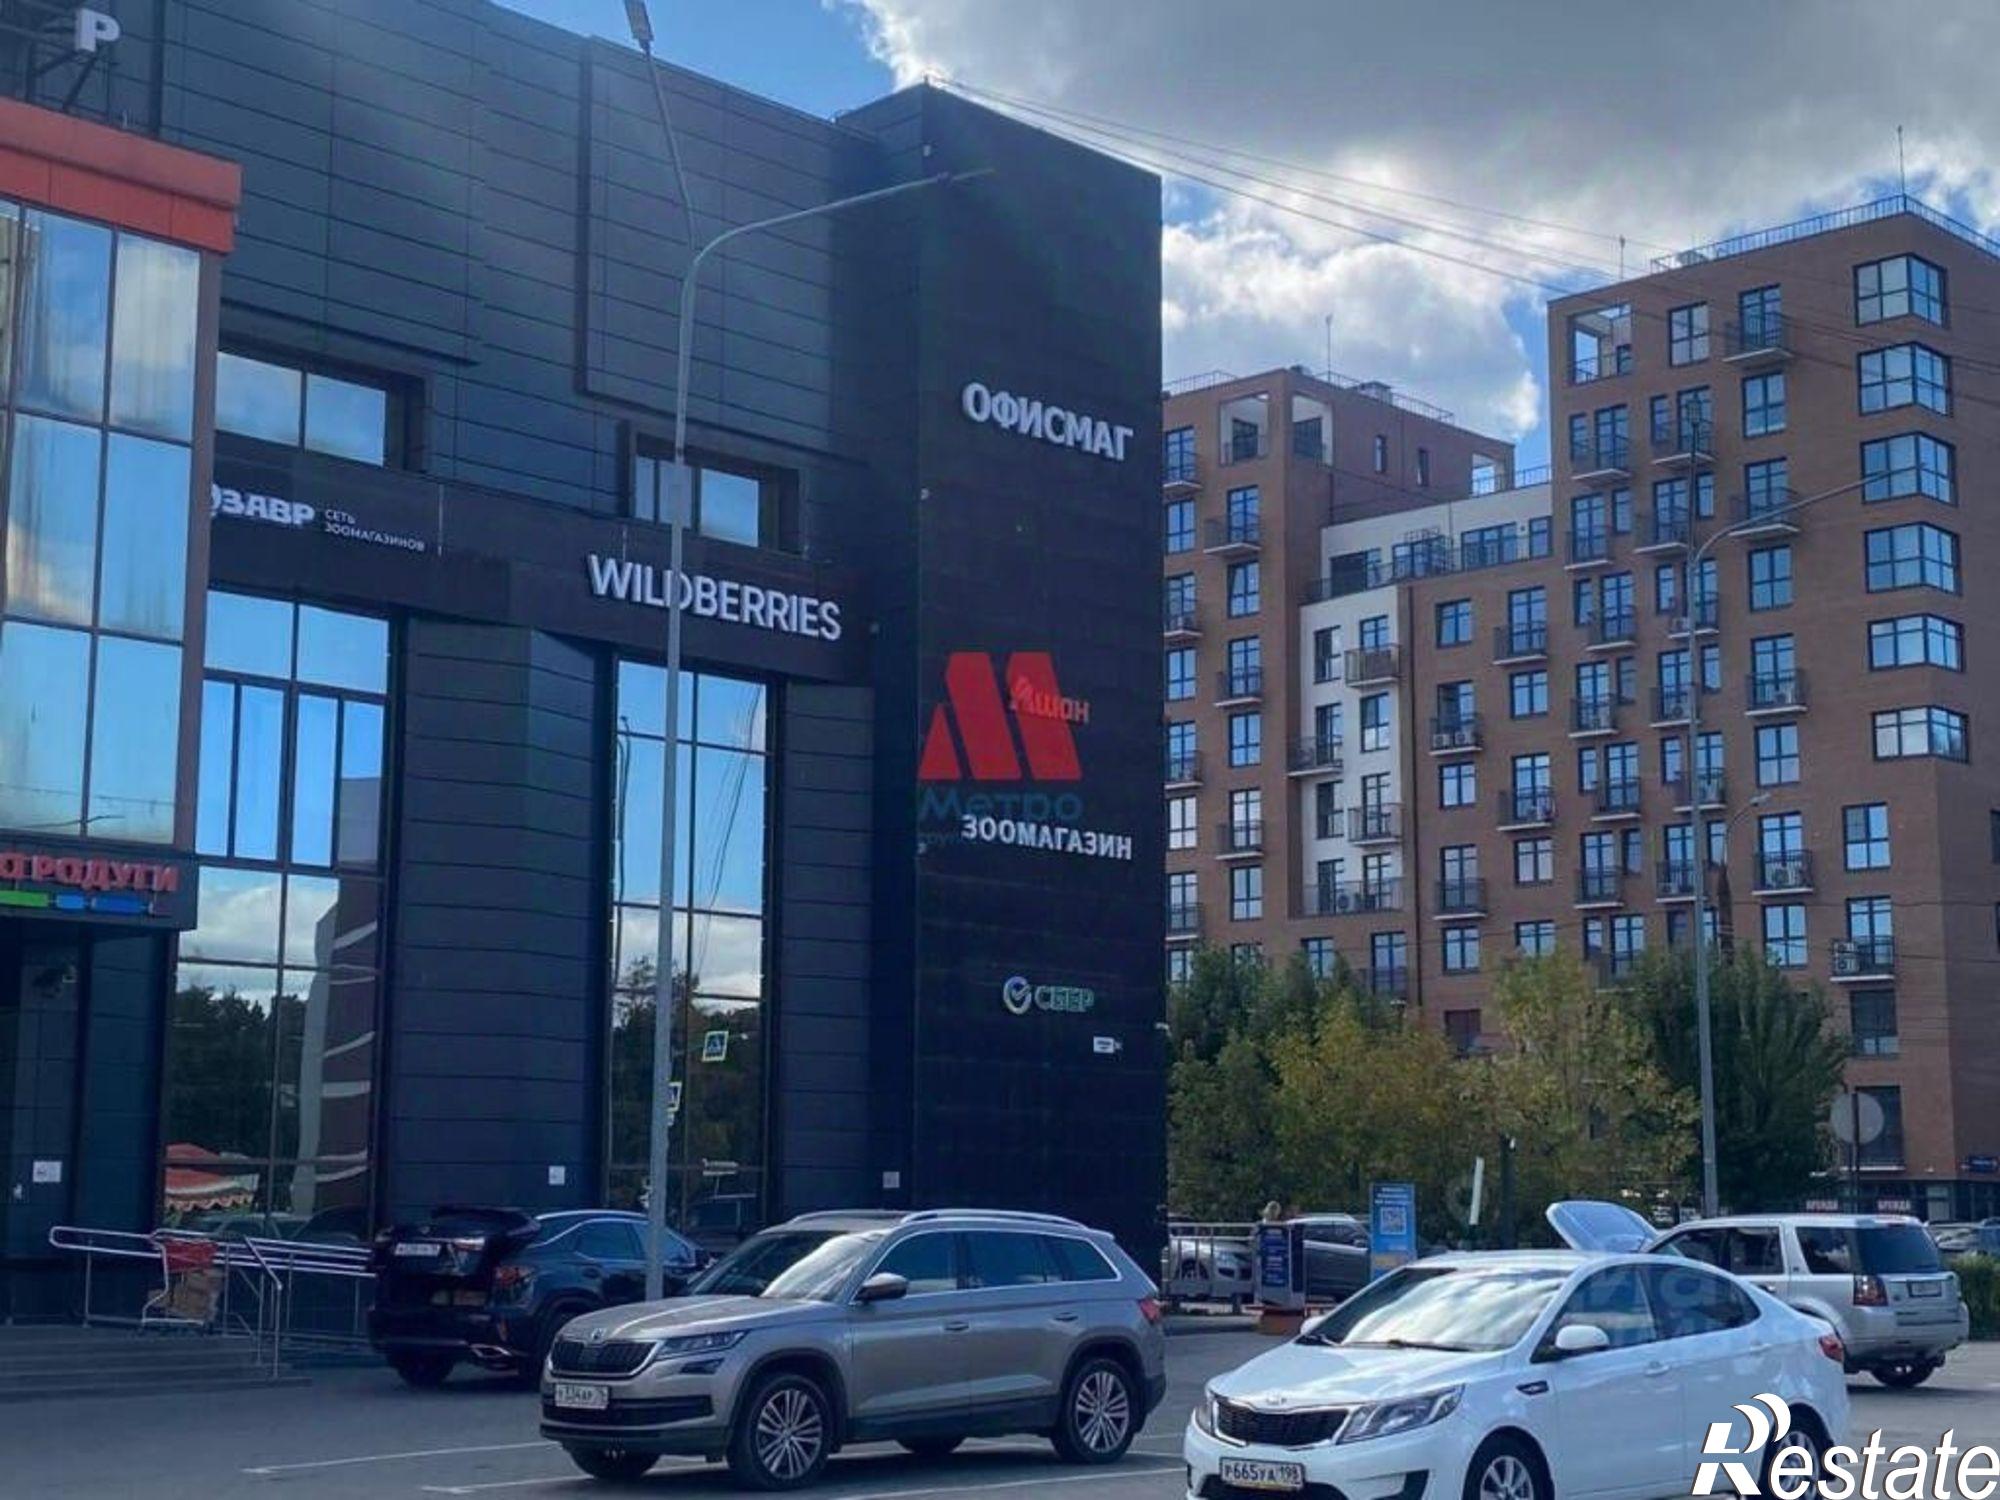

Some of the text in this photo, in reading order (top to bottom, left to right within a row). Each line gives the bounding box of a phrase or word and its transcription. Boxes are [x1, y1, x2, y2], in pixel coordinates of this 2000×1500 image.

[962, 382, 1135, 461] ОФИСМАГ
[325, 509, 356, 525] СЕТЬ
[325, 522, 425, 552] ЗООМАГАЗИНОВ
[587, 554, 842, 641] WILDBERRIES
[961, 814, 1133, 861] ЗООМАГАЗИН
